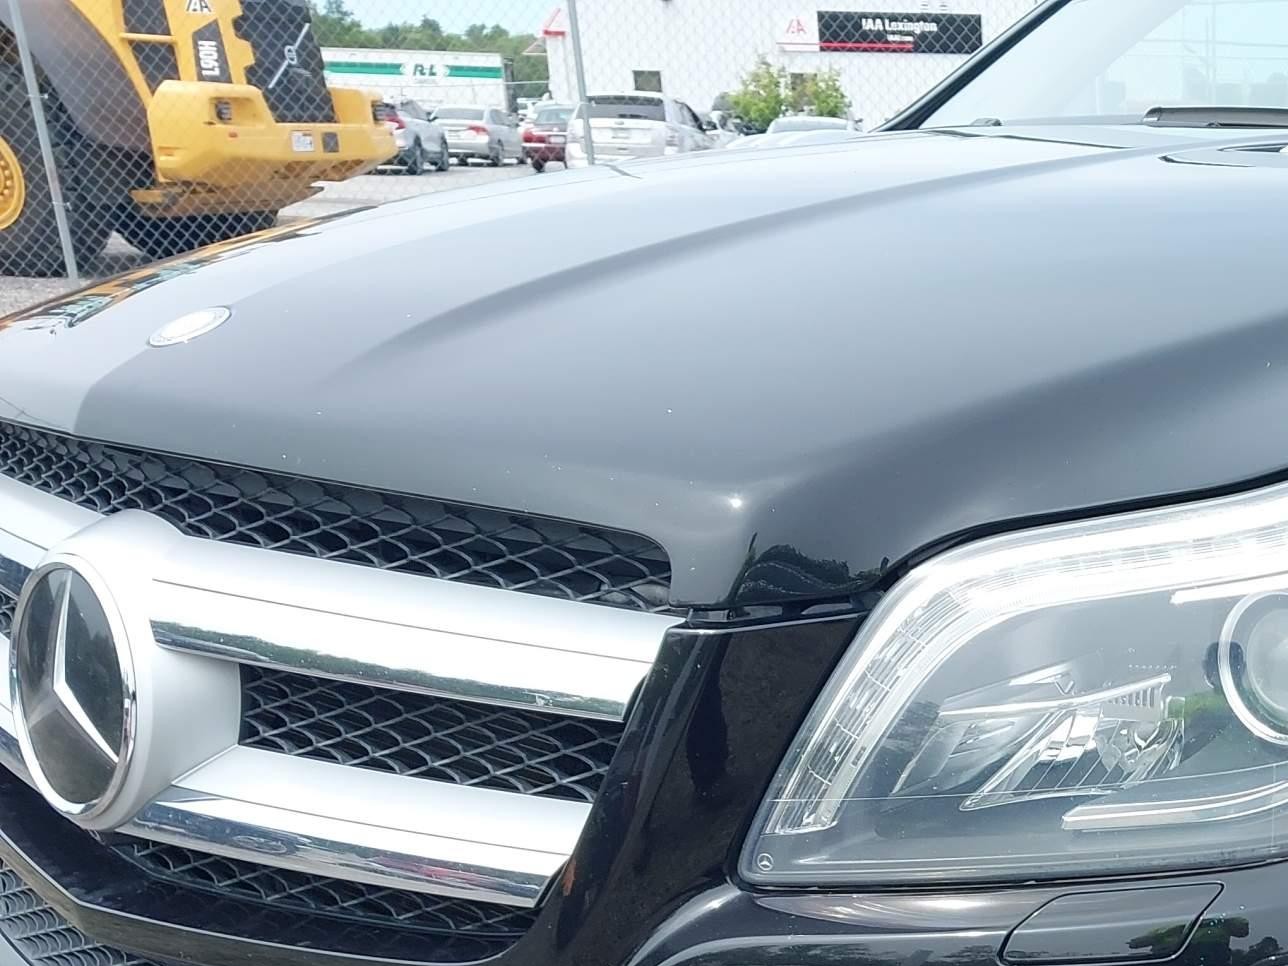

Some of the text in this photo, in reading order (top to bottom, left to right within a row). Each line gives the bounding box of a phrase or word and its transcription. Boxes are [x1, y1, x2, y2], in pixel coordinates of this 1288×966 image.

[861, 18, 937, 34] IAA Lexington
[197, 40, 220, 77] L90H
